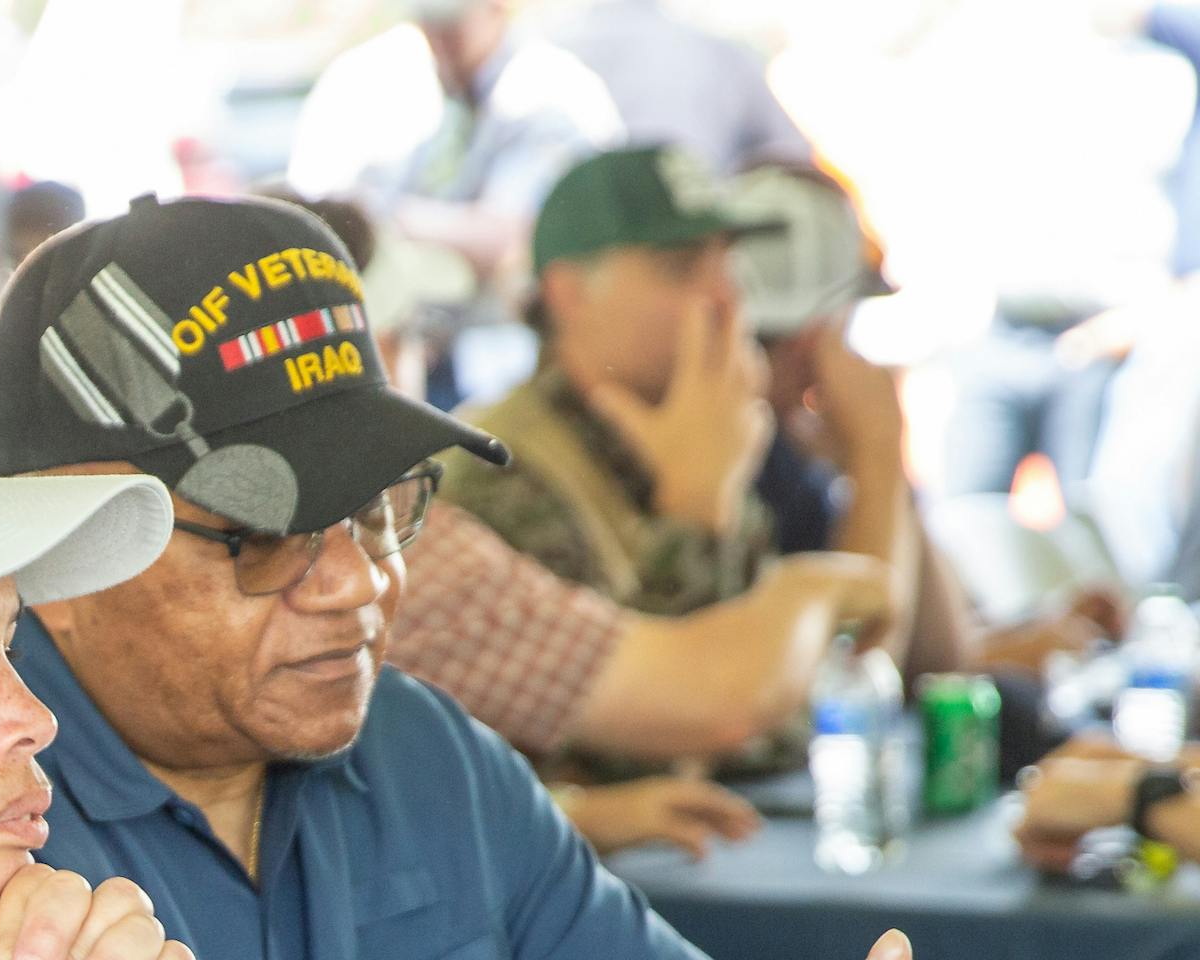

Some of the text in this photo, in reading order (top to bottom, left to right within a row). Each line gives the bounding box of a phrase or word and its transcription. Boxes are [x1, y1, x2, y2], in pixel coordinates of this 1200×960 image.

[172, 247, 364, 354] OIF VETERA
[284, 340, 364, 393] IRAQ
